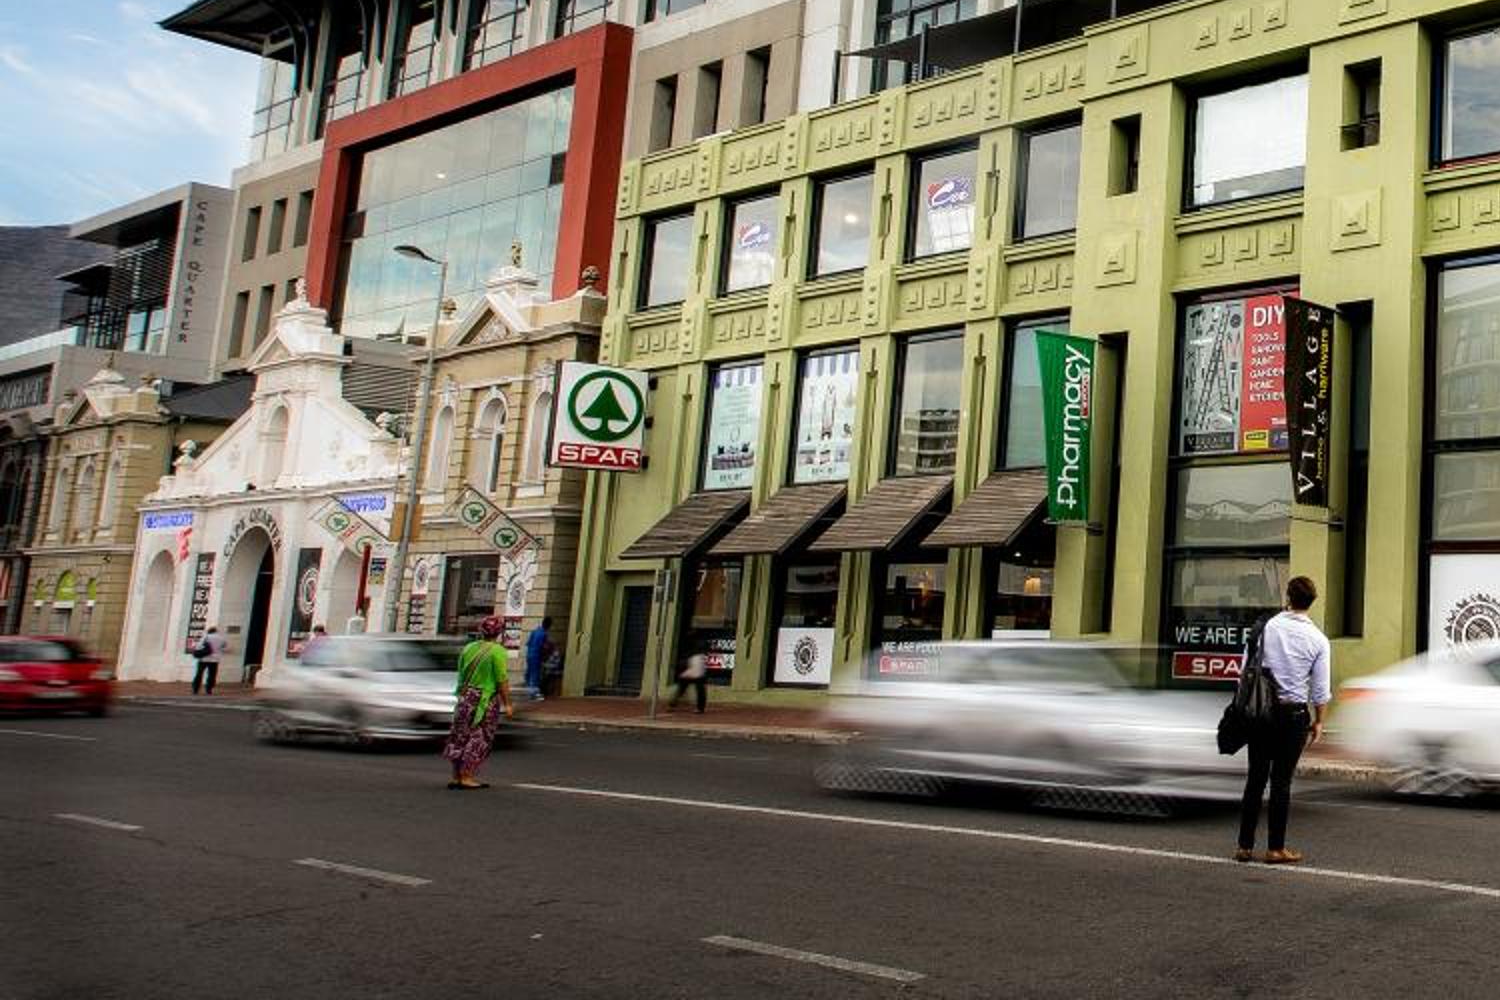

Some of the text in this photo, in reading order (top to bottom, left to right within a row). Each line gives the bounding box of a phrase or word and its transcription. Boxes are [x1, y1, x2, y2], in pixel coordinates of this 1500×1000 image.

[1253, 304, 1286, 327] DIY
[1298, 308, 1322, 495] VILLAGE
[1057, 343, 1091, 509] Pharmacy
[559, 444, 640, 466] SPAR
[1175, 626, 1201, 644] WE
[1204, 627, 1237, 645] ARE
[1192, 658, 1241, 675] SPA
